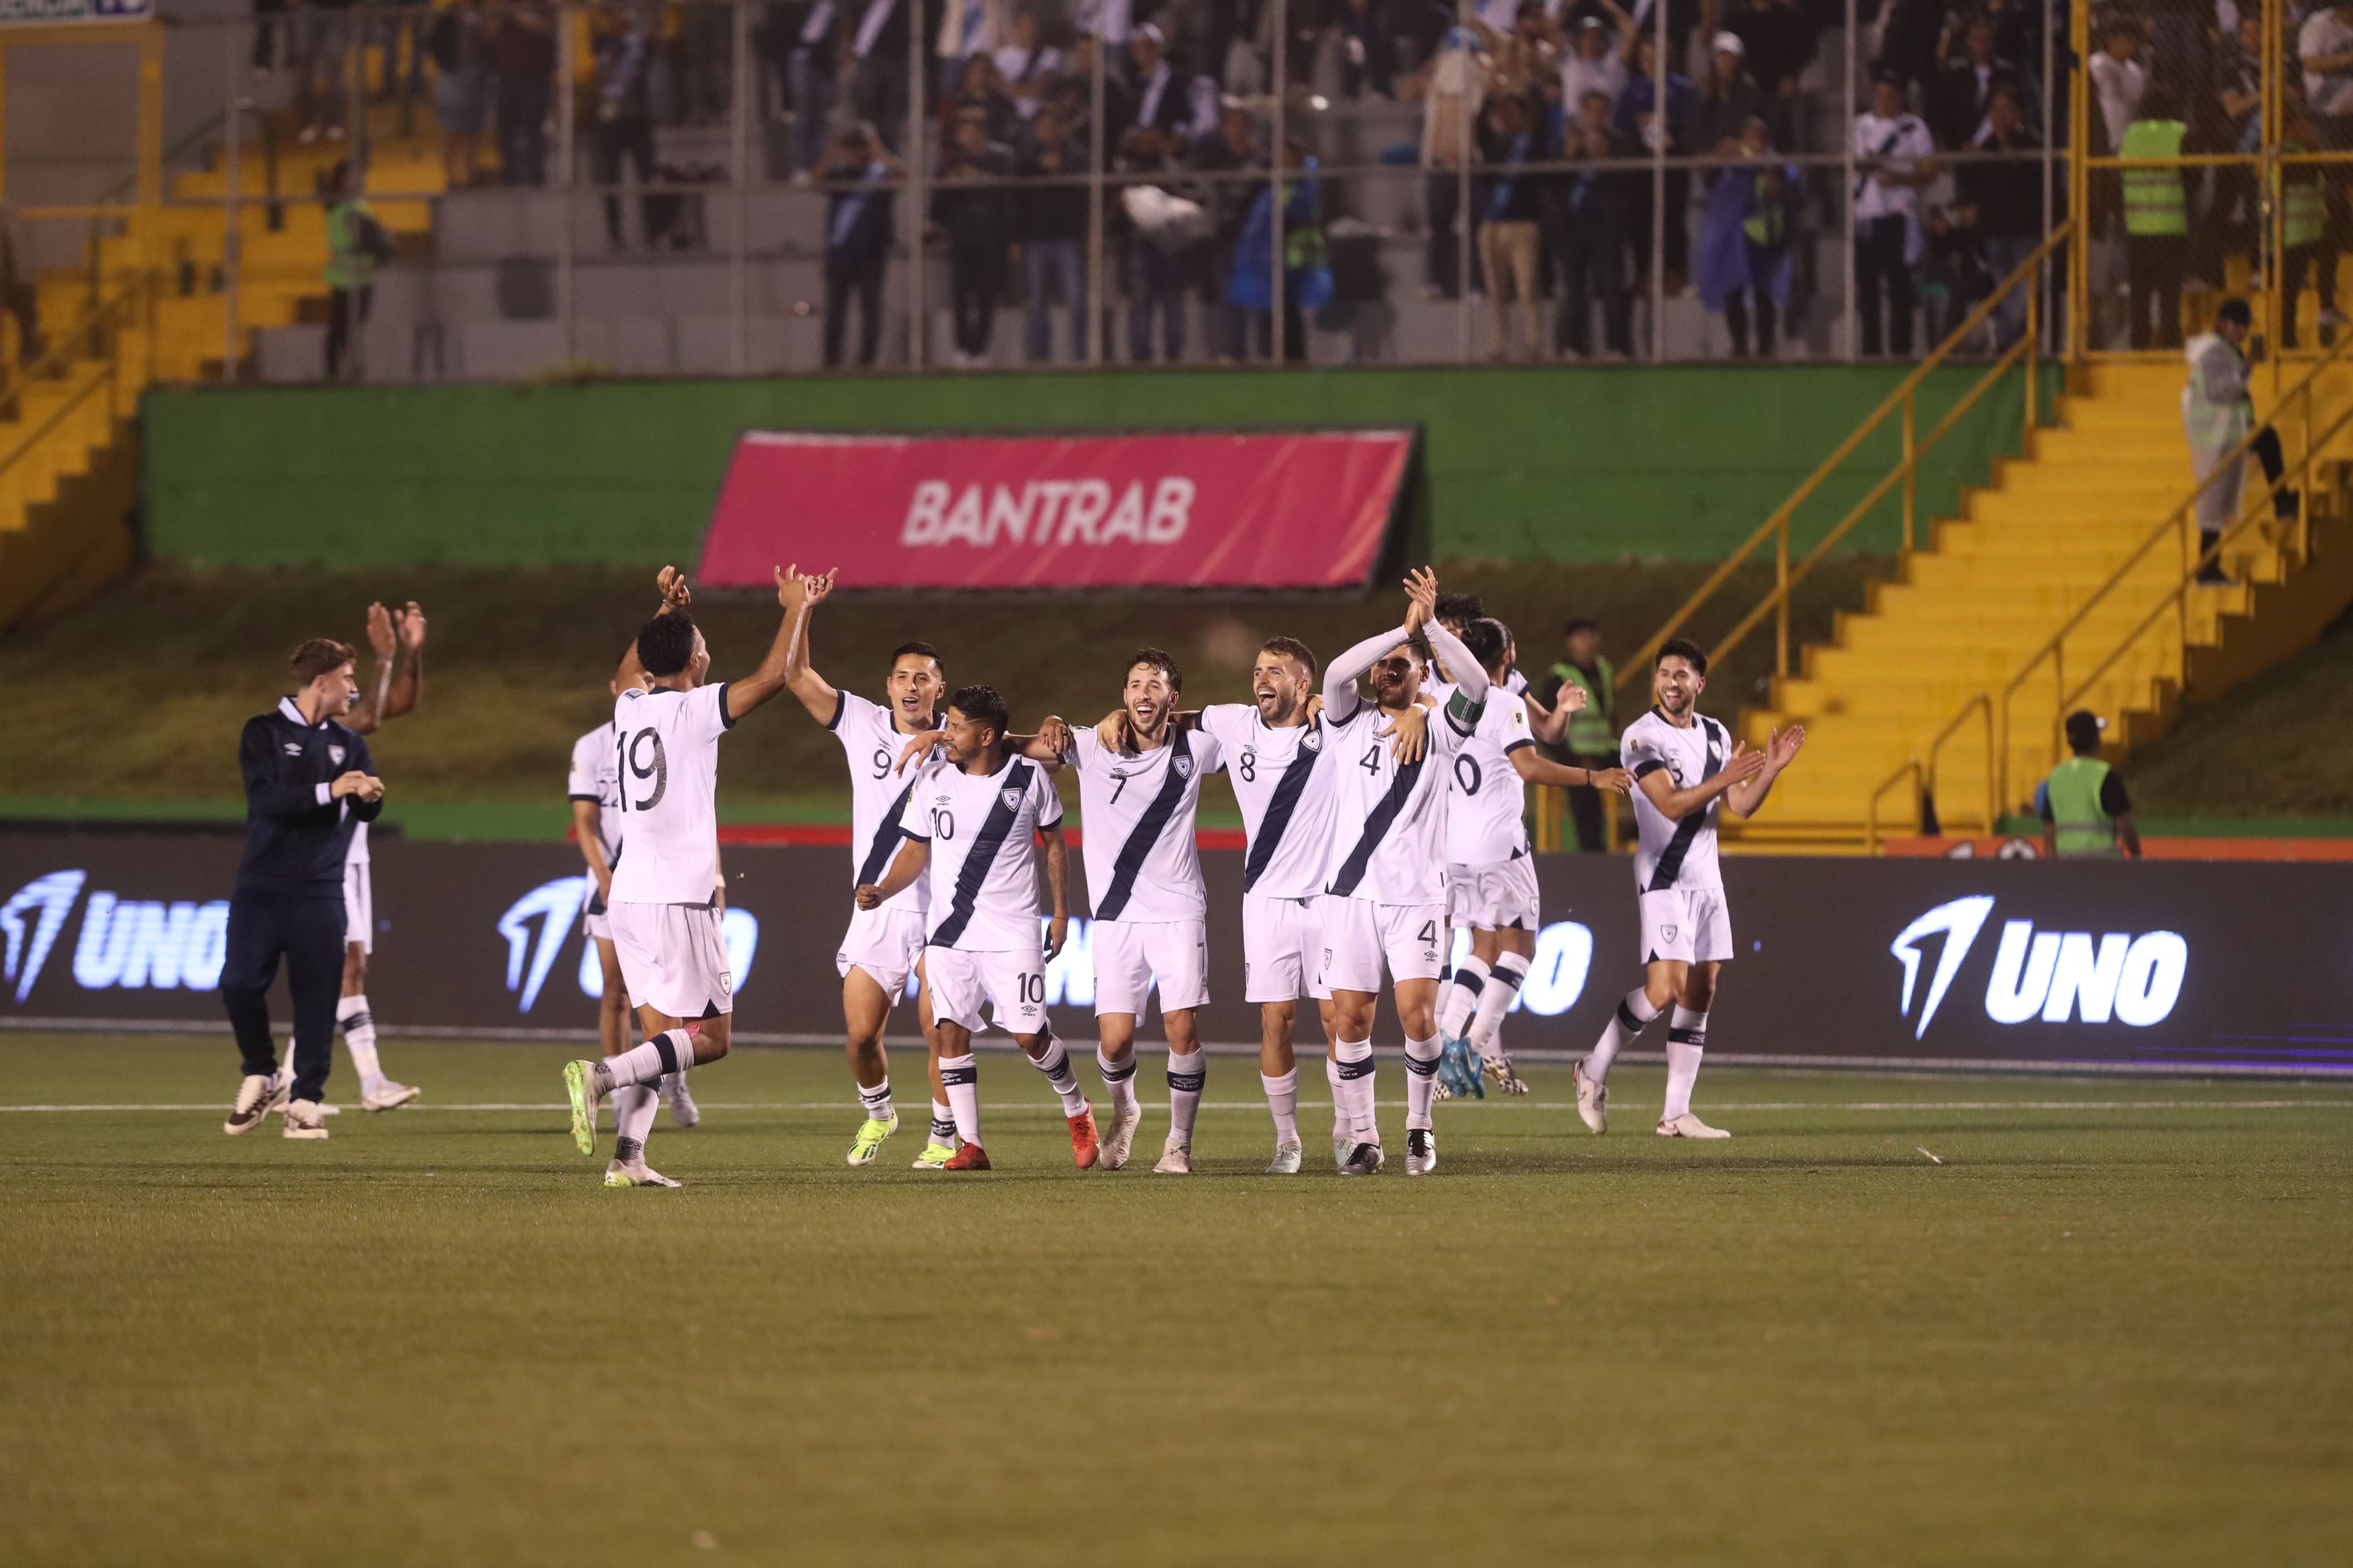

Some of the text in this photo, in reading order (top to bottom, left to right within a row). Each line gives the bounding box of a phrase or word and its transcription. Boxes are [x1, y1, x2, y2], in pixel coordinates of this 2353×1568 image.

[900, 477, 1195, 546] BANTRAB
[617, 727, 667, 813] 19
[873, 749, 892, 780] 9
[1240, 752, 1256, 782] 8
[1359, 745, 1381, 776] 4
[1449, 753, 1481, 796] 0
[1109, 774, 1127, 805] 7
[931, 807, 954, 840] 10
[73, 891, 231, 991] UNO
[1417, 920, 1438, 948] 4
[1018, 973, 1044, 1003] 10
[1985, 919, 2187, 1026] UNO
